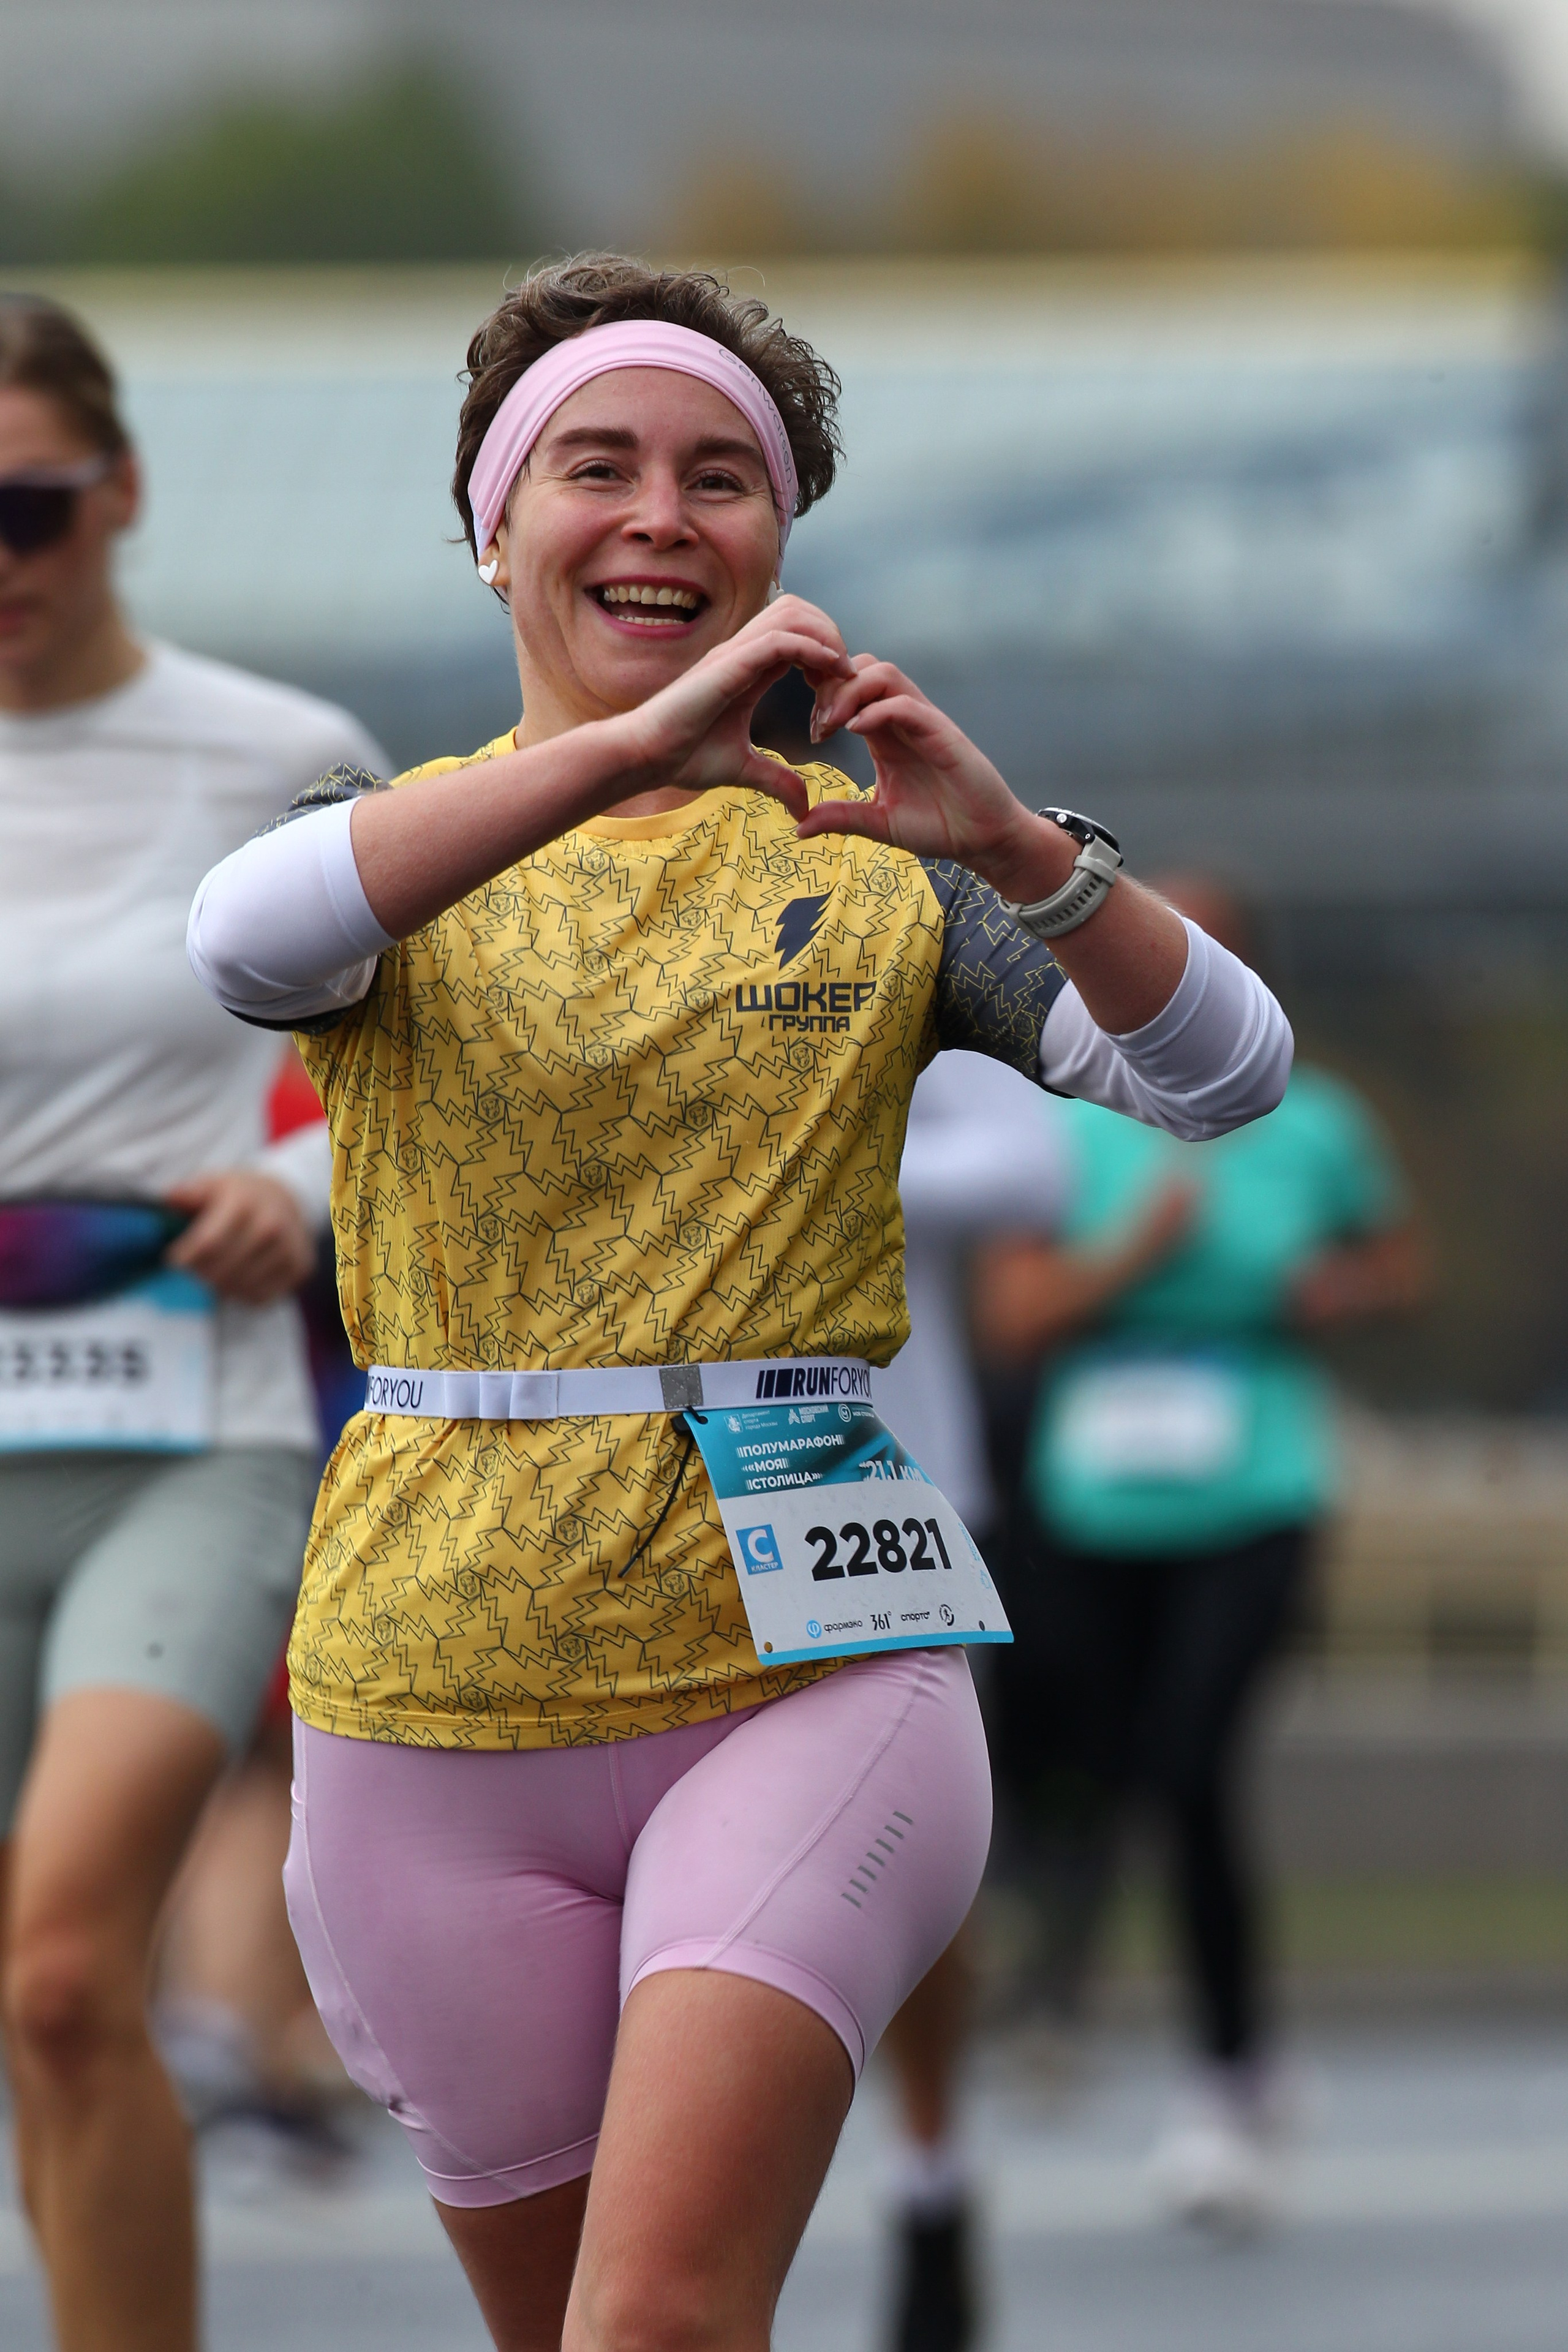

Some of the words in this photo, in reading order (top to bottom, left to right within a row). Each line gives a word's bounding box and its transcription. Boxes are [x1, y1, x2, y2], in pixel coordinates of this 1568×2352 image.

[735, 981, 877, 1012] ШОКЕР
[769, 1014, 850, 1033] ГРУППА
[793, 1366, 872, 1400] RUNFORYO
[804, 1517, 952, 1581] 22821
[751, 1562, 778, 1572] КЛАСТЕР
